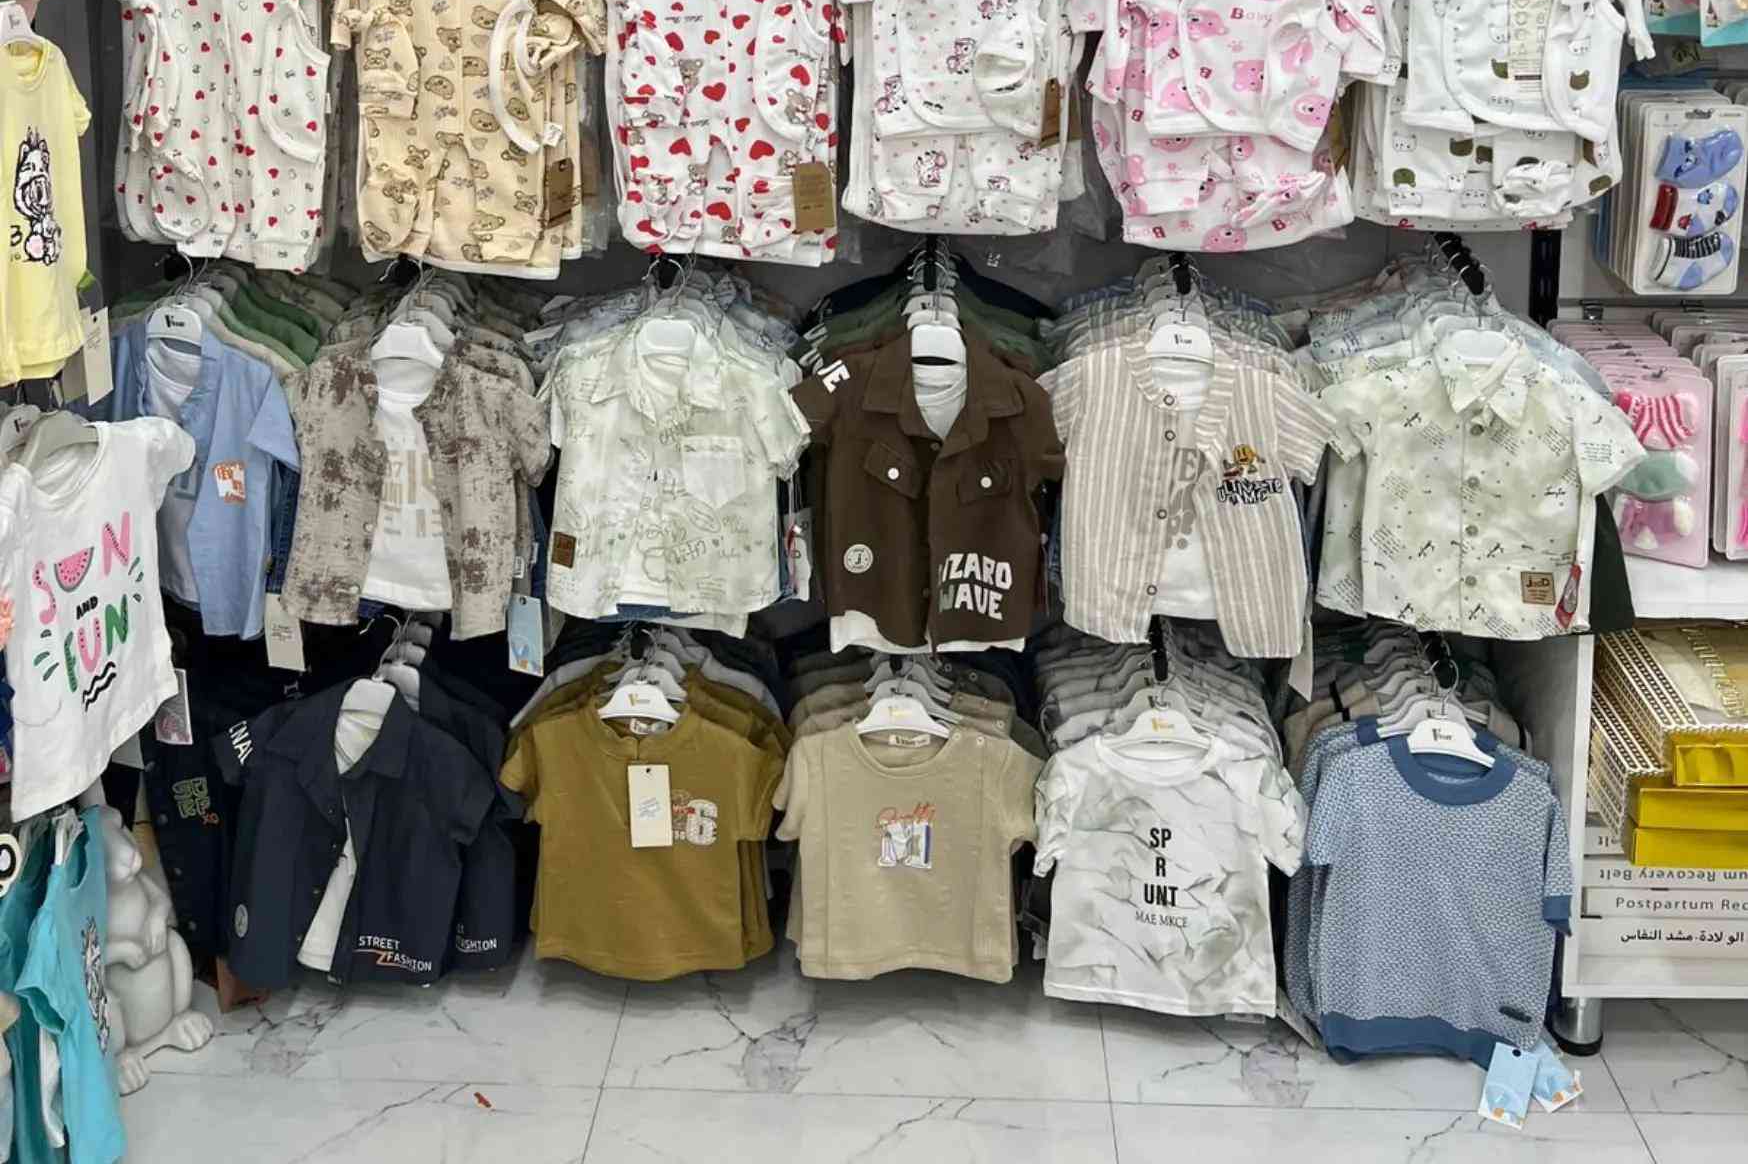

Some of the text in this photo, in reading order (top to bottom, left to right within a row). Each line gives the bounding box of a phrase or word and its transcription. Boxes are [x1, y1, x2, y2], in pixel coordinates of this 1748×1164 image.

[76, 596, 99, 620] AND
[63, 594, 129, 693] FUN
[1150, 827, 1172, 849] SP
[1155, 856, 1167, 878] R
[1599, 868, 1633, 881] Belt
[1638, 867, 1716, 883] Recovery
[1144, 883, 1179, 907] UNT
[1615, 897, 1714, 911] Postpartum
[358, 935, 400, 951] STREET
[387, 951, 432, 972] FASHION
